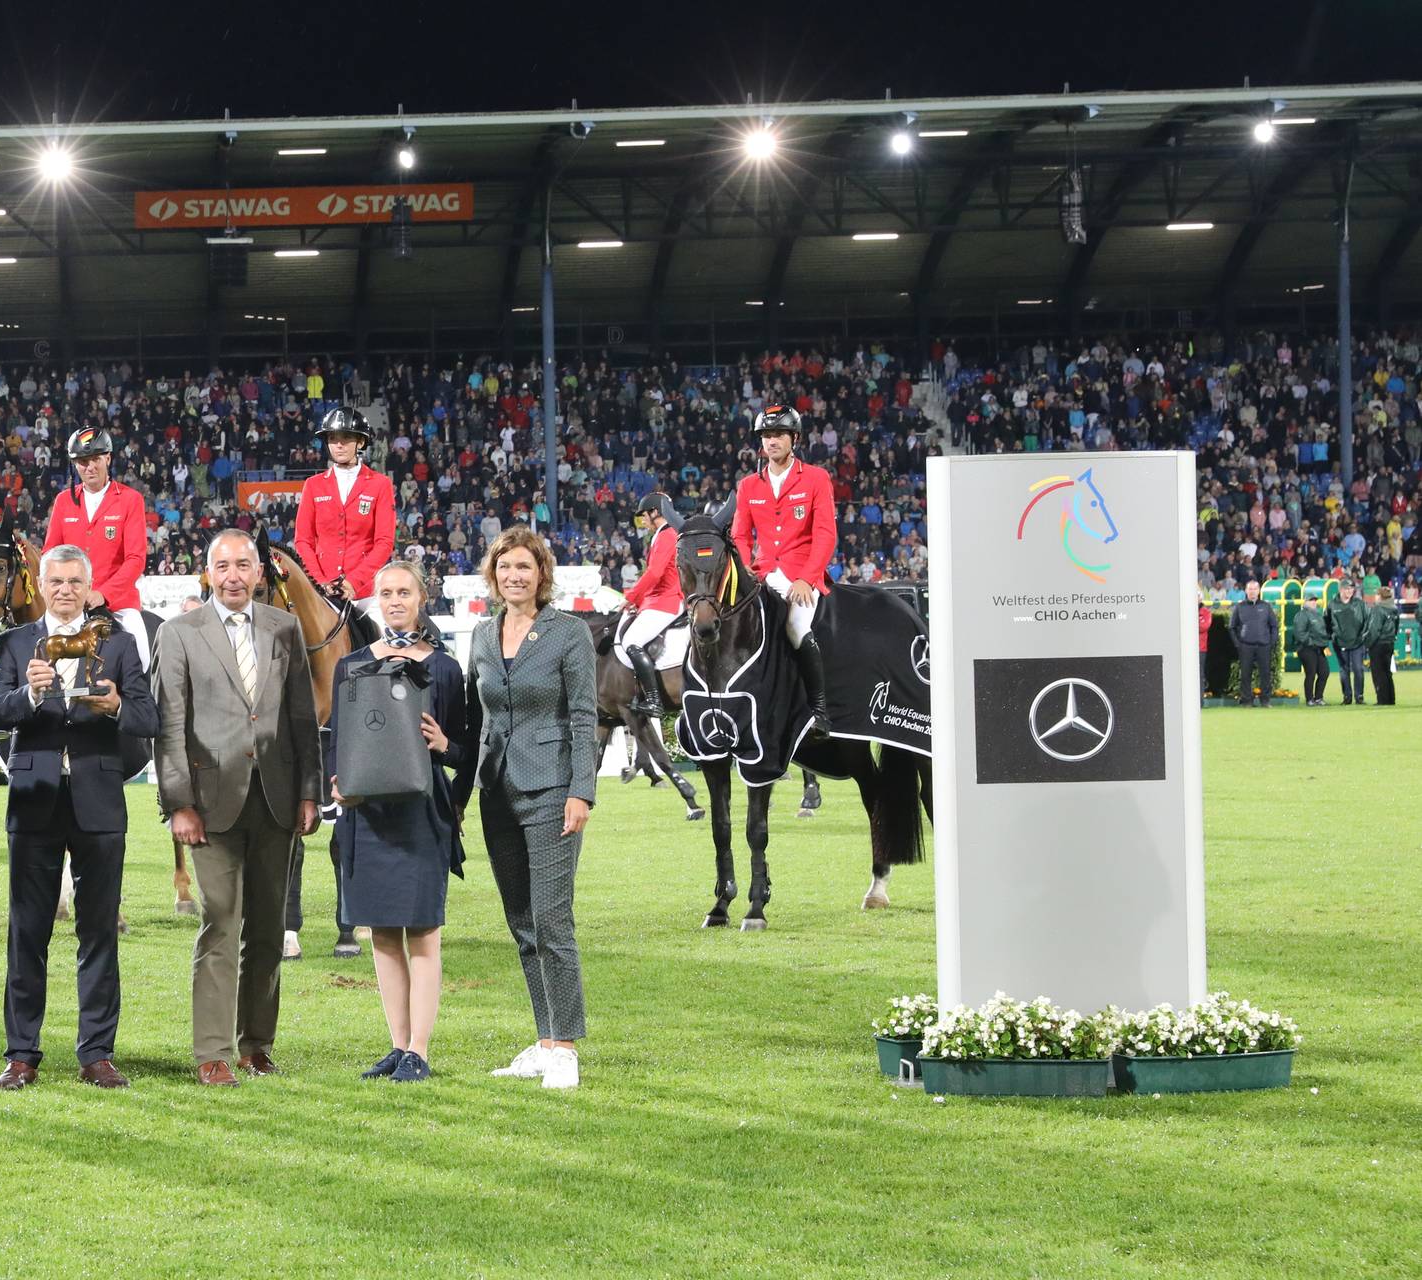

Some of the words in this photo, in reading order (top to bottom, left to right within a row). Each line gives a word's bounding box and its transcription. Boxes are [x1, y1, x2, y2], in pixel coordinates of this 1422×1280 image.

[184, 197, 291, 218] STAWAG
[353, 193, 460, 215] STAWAG
[607, 326, 625, 345] D
[33, 339, 50, 359] C
[992, 593, 1045, 607] Weltfest
[1047, 593, 1069, 605] des
[1071, 592, 1146, 606] Pferdesports
[888, 704, 908, 716] World
[883, 714, 902, 726] CHIO
[900, 719, 925, 733] Aachen
